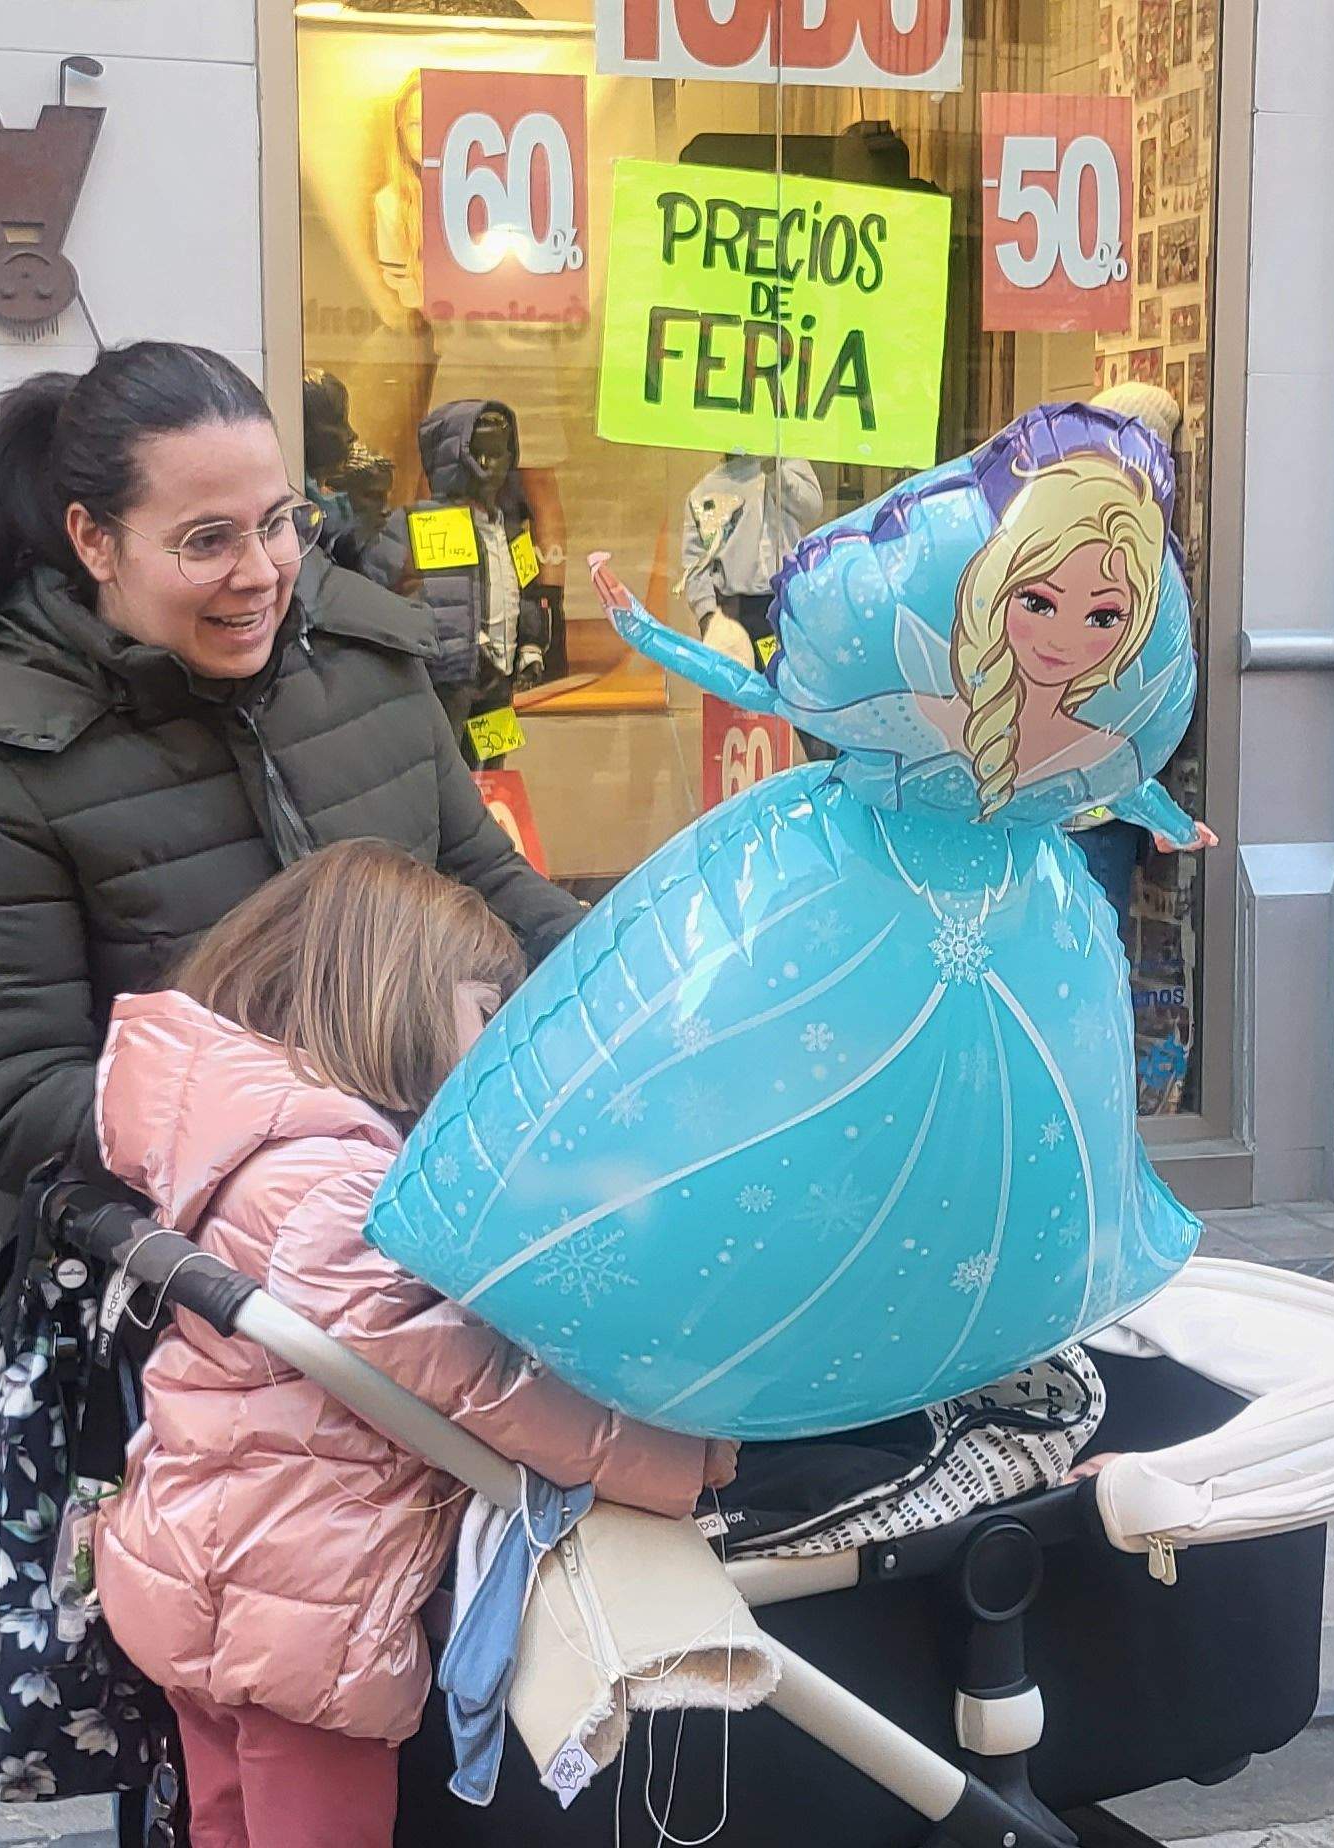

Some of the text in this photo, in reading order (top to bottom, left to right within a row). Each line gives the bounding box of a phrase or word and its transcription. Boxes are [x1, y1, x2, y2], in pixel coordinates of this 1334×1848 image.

[423, 112, 583, 273] -60%
[982, 136, 1127, 289] -50%
[751, 281, 794, 320] DE
